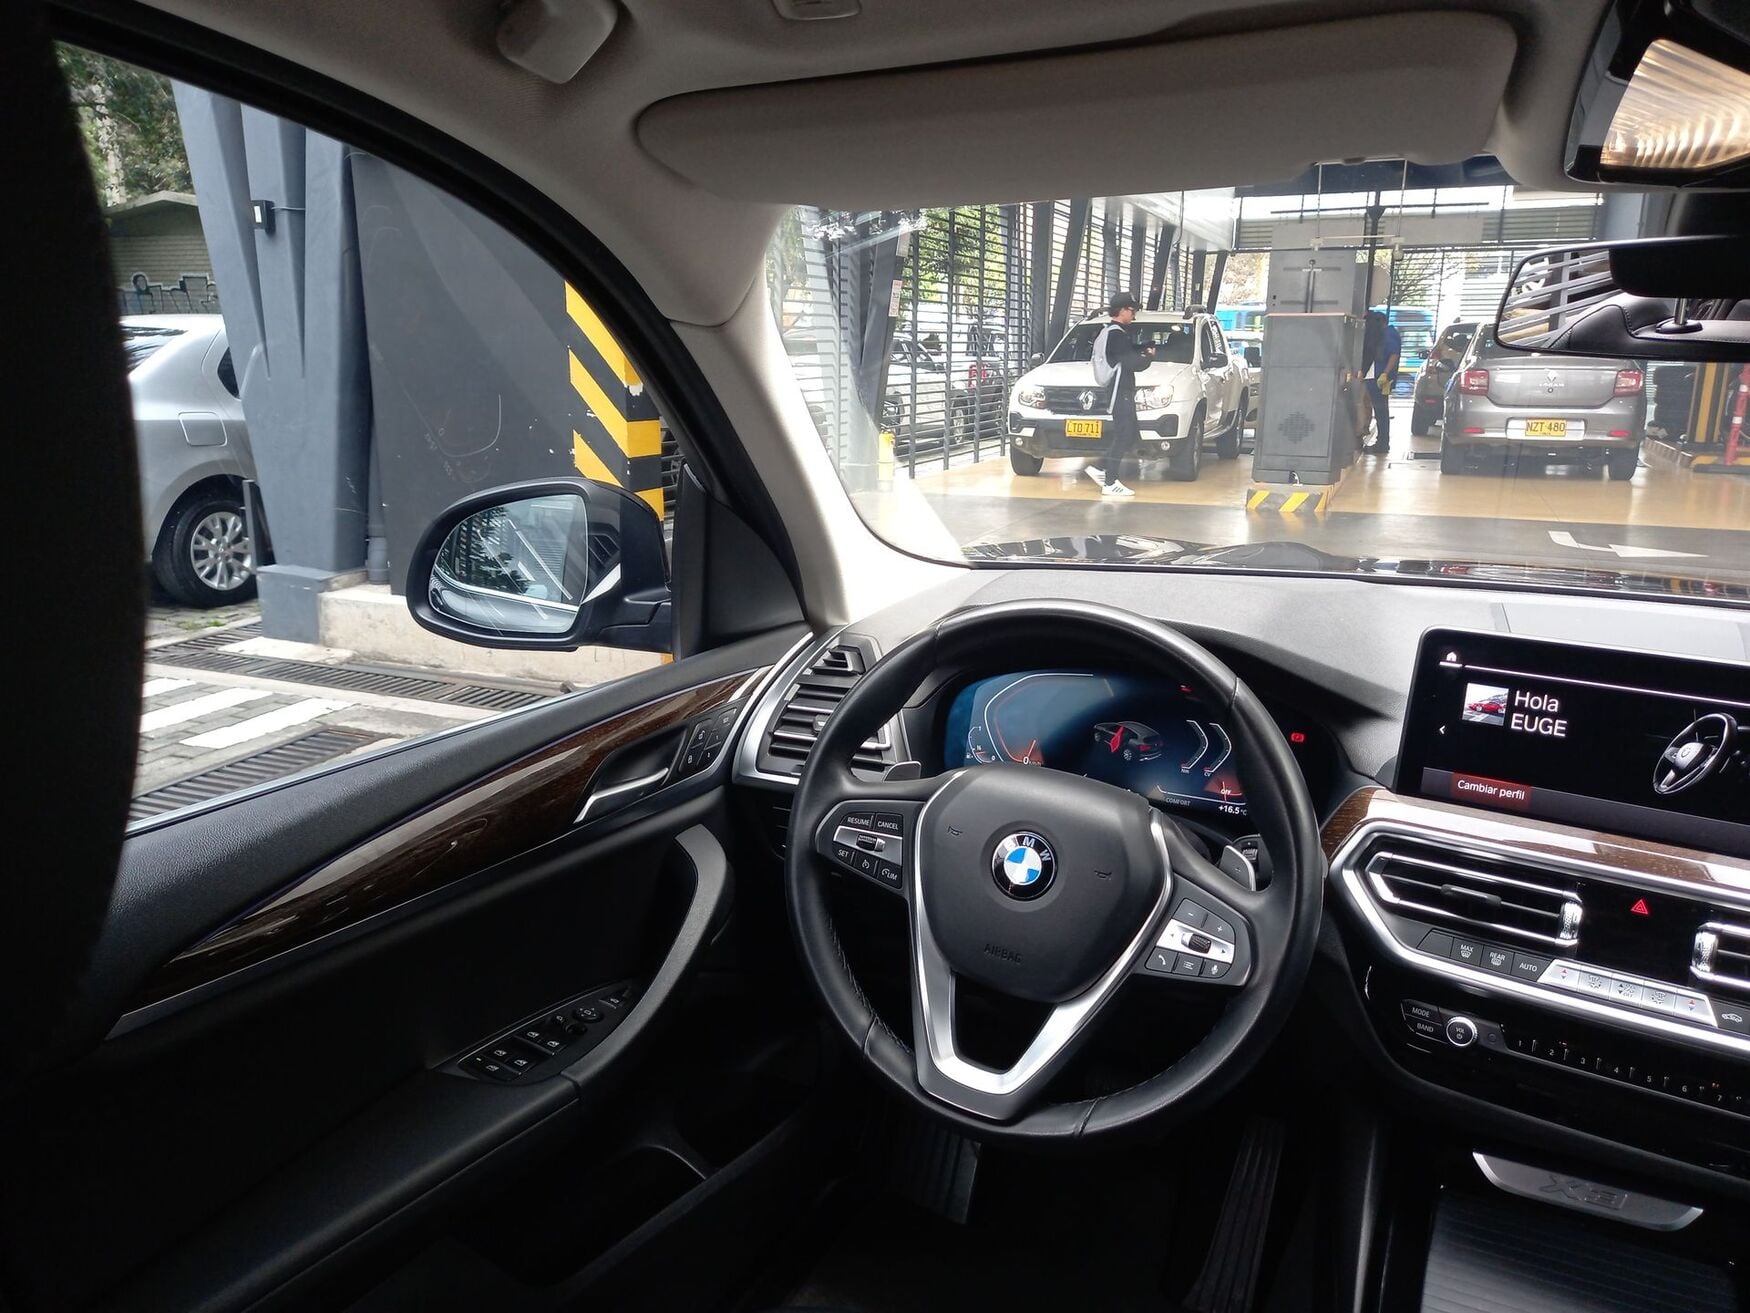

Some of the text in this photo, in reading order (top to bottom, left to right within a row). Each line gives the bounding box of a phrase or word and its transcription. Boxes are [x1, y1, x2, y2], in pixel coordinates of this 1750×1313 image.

[1085, 423, 1099, 433] 711
[1526, 422, 1566, 432] NZT 480
[1514, 690, 1559, 712] Hola
[1510, 712, 1568, 737] EUGE
[1023, 756, 1029, 765] 0
[1457, 780, 1525, 801] Cambiar perfil
[1165, 797, 1191, 807] COMFORT
[847, 816, 870, 826] RESUME
[877, 821, 899, 830] CANCEL
[1003, 836, 1051, 861] BMW
[838, 850, 849, 858] SET
[983, 943, 1022, 964] AIRBAG
[1460, 944, 1474, 953] MAX
[1489, 951, 1506, 961] REAR
[1519, 962, 1538, 973] AUTO
[1411, 1006, 1430, 1018] MODE
[1416, 1022, 1434, 1033] BAND
[1455, 1026, 1465, 1034] VOL
[1646, 1075, 1652, 1083] 5
[1682, 1085, 1688, 1093] 6
